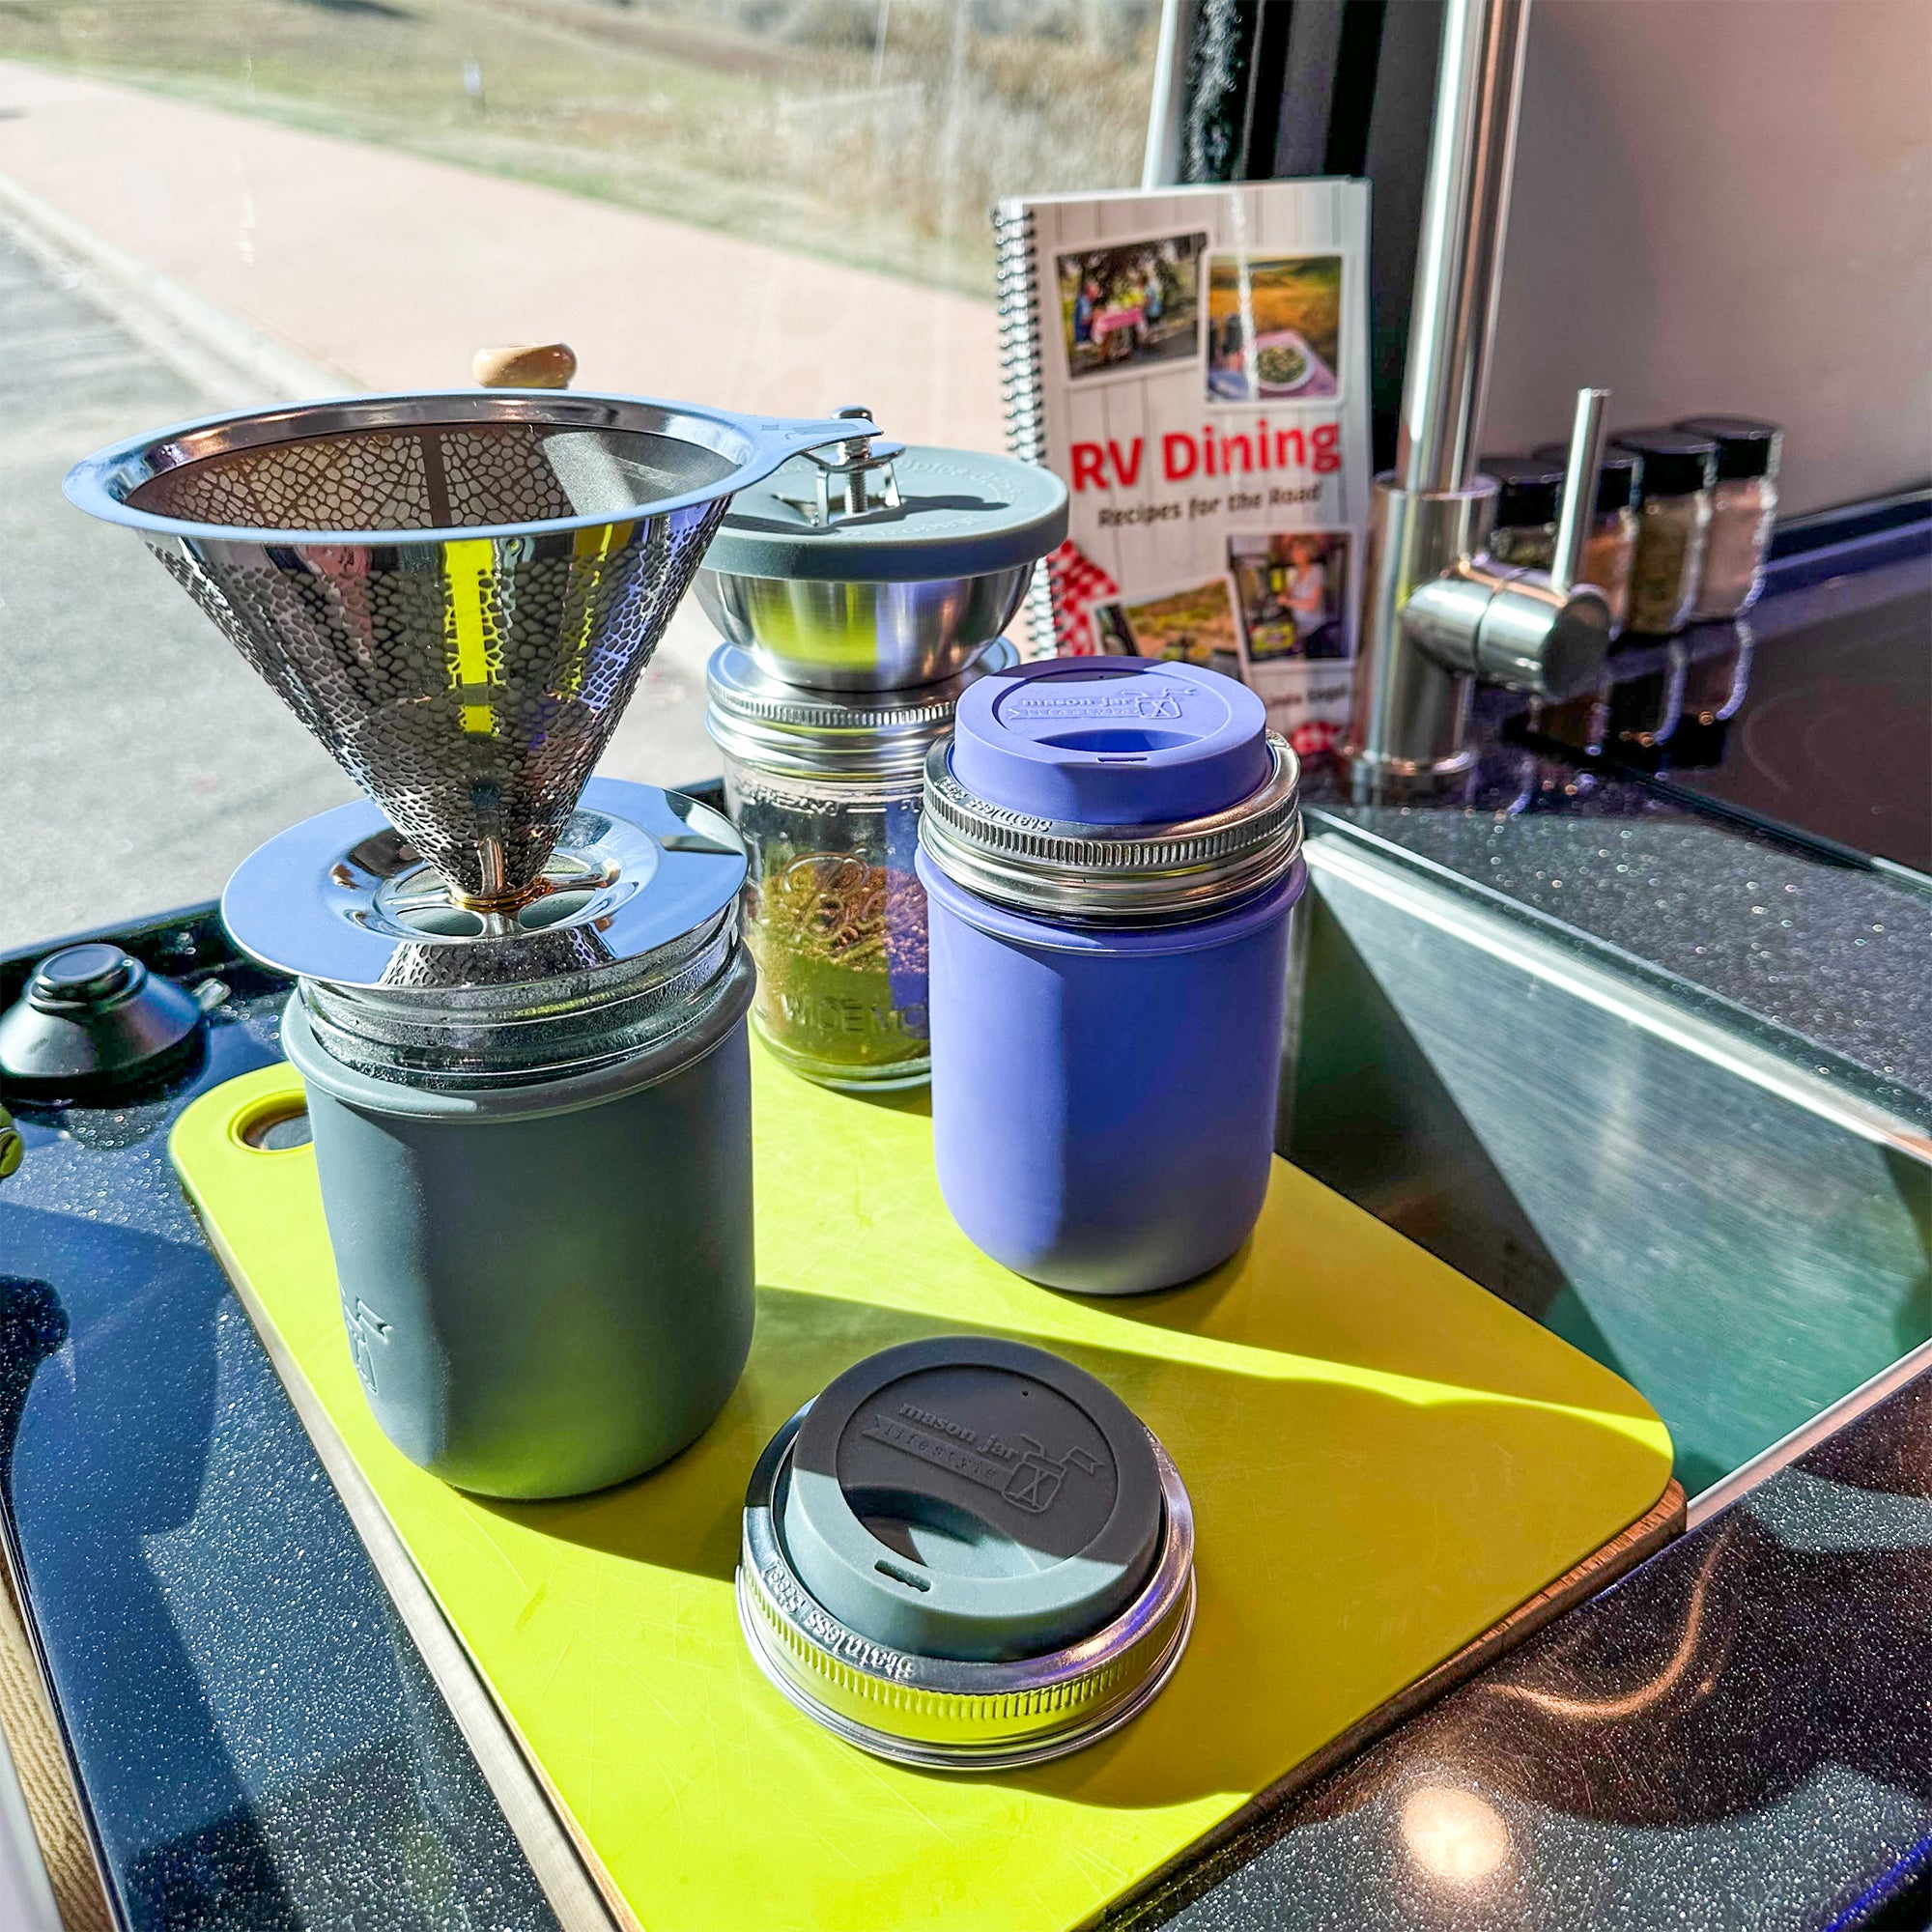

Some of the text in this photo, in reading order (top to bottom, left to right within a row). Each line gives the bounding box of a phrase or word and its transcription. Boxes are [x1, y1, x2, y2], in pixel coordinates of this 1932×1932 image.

[1069, 435, 1144, 493] RV
[1162, 417, 1343, 483] Dining
[1097, 481, 1322, 527] Recipes for the Road
[1021, 696, 1095, 707] mason
[883, 1422, 998, 1480] lifestyle
[897, 1402, 1020, 1462] mason jar
[759, 1557, 916, 1682] Stainless Steel
